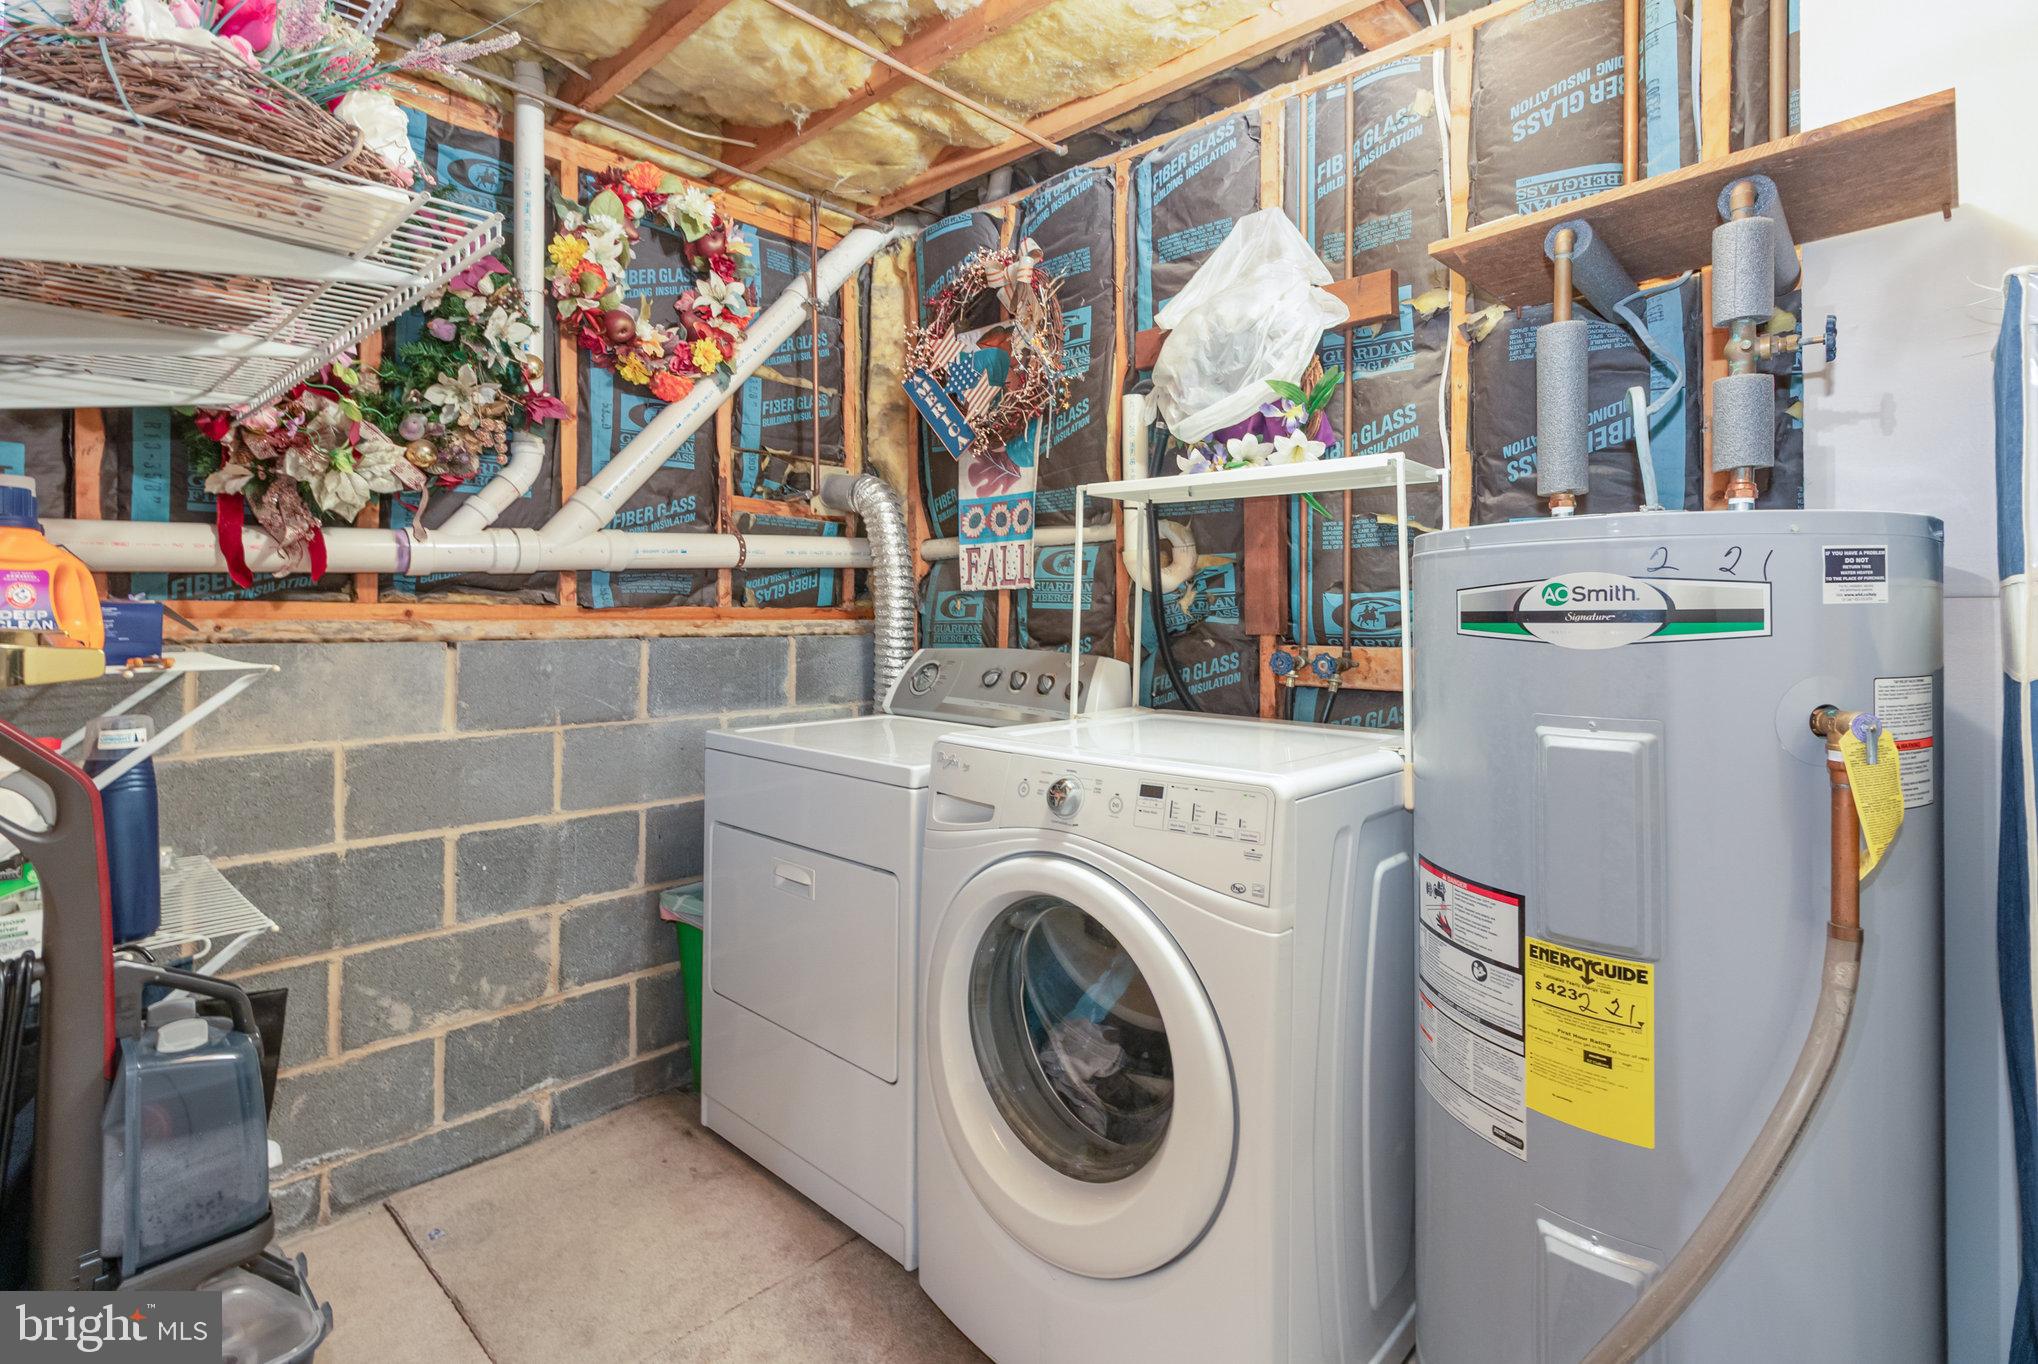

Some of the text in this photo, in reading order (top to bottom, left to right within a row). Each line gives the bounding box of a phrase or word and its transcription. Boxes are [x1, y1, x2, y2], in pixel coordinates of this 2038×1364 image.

[1510, 67, 1591, 120] INSULATION
[1511, 89, 1585, 142] GLASS
[1153, 119, 1235, 191] FIBER GLASS
[1317, 138, 1362, 184] FIBR
[1359, 124, 1424, 172] INSULATION
[1153, 137, 1237, 207] BUILDING INSULATION
[1051, 177, 1094, 213] INSULATION
[1515, 173, 1624, 200] BERGLASS
[624, 267, 692, 287] IBER GLAS
[762, 398, 794, 416] FIBER
[911, 373, 971, 450] AMERICA
[1055, 397, 1090, 431] GLASS
[762, 414, 792, 428] BUILDING
[1053, 415, 1090, 446] INSULATION
[1360, 403, 1417, 443] GLASS
[613, 495, 697, 529] FIBER GLASS
[651, 513, 697, 532] INSULATION
[966, 544, 1032, 587] FALL
[169, 573, 233, 599] FIBE
[755, 573, 818, 604] FIBER GLAS
[1032, 591, 1092, 603] FIBERGLSS
[1034, 581, 1093, 592] GUARDN
[1572, 584, 1635, 602] Smith
[0, 610, 47, 619] DEEP
[1564, 611, 1614, 623] Signature
[934, 624, 982, 635] GUARDIAN
[1153, 652, 1240, 692] FIBR GLASS
[1188, 672, 1241, 695] INSULATION
[1365, 705, 1405, 729] GLA
[1535, 981, 1578, 1000] $ 423
[1557, 1028, 1612, 1048] First Hour Rating
